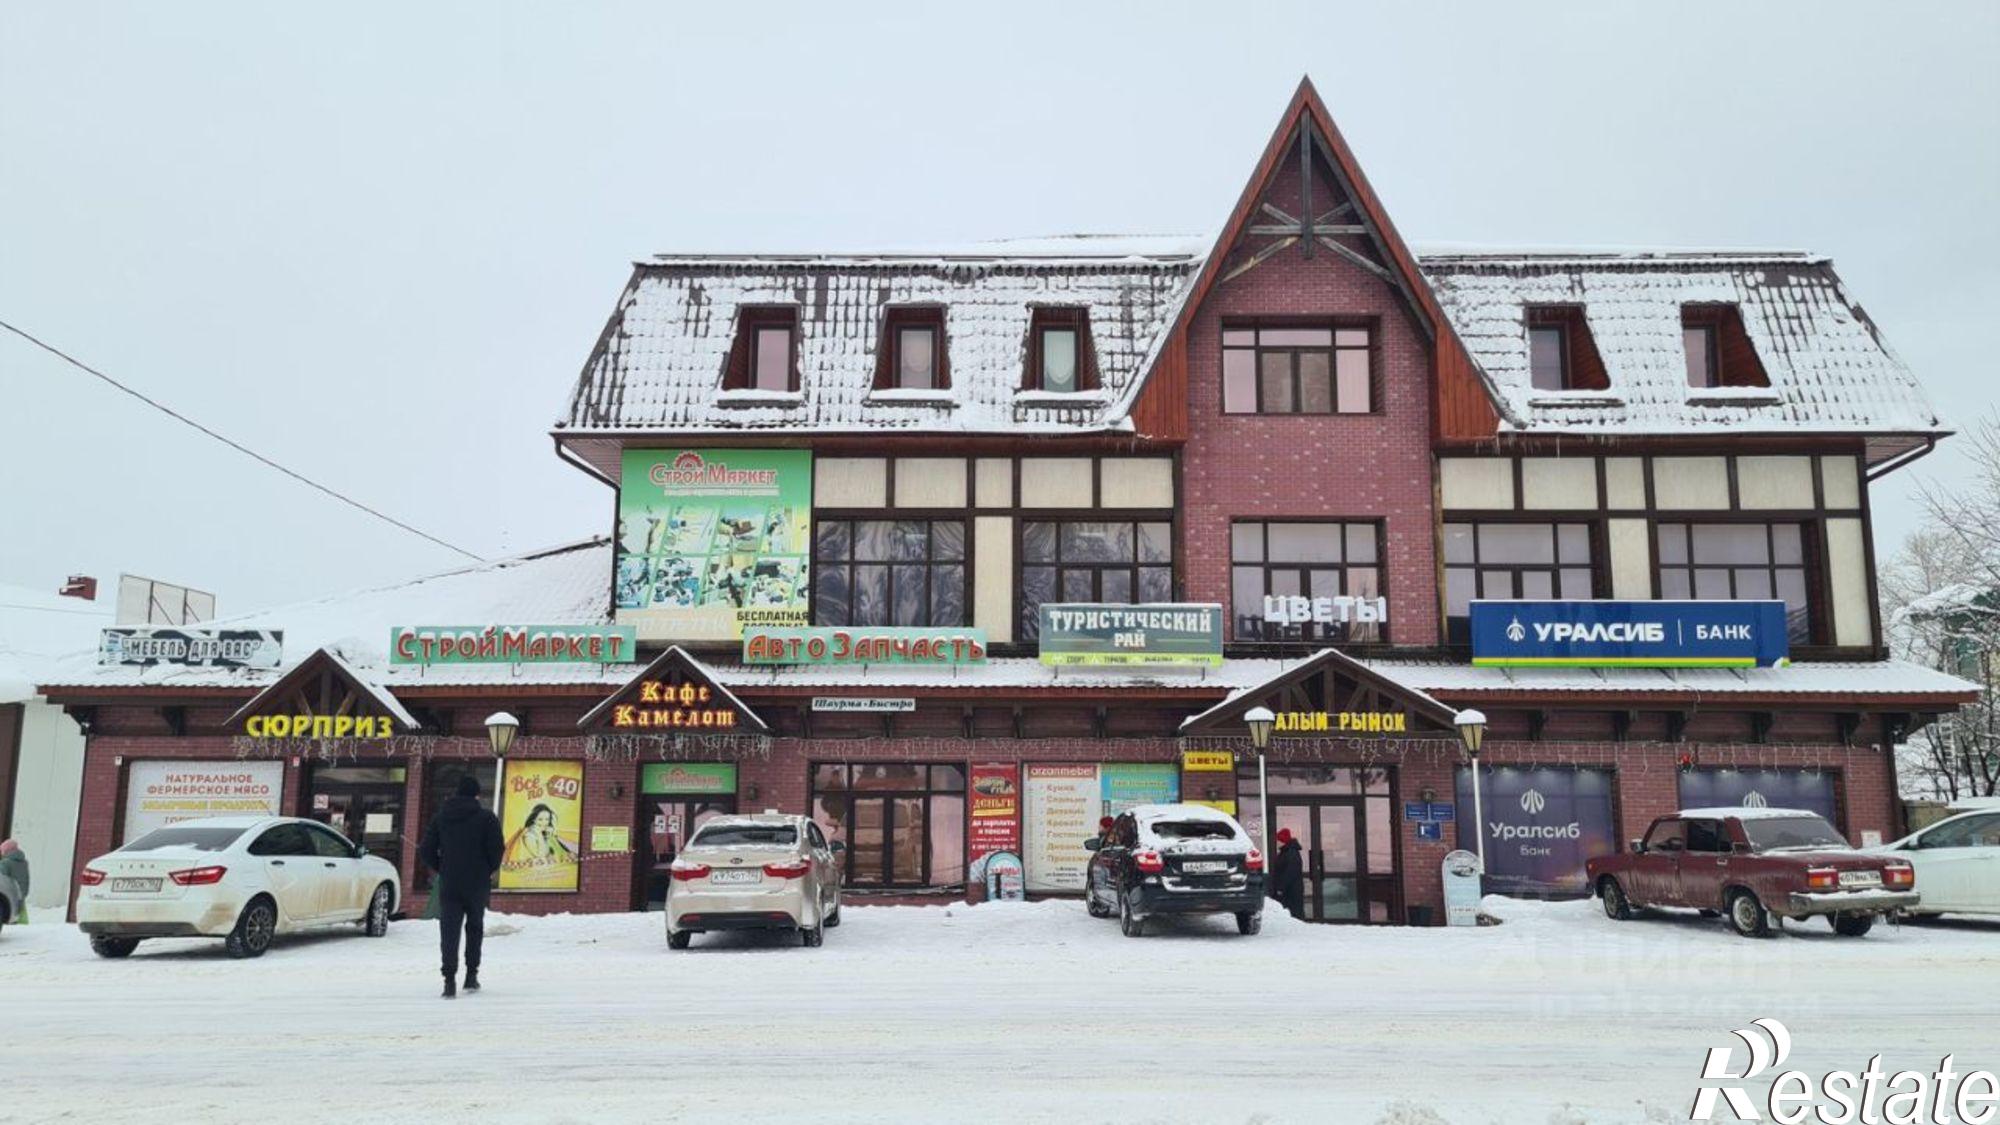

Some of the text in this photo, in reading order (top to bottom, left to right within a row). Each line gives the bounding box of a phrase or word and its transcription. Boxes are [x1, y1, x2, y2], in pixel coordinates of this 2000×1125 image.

[1264, 595, 1387, 626] ЦВЕТЫ
[1050, 609, 1213, 633] ТУРИСТИЧЕСКИЙ
[1113, 630, 1146, 648] РАЙ
[1533, 622, 1752, 642] УРАЛСИБ БАНК
[190, 640, 221, 661] ДЛЯ
[640, 681, 711, 706] Кафе
[613, 704, 736, 727] Камелот
[1340, 711, 1406, 732] РЫНОК
[246, 714, 394, 739] СЮРПРИЗ
[1188, 757, 1228, 765] ЦВЕТЫ
[165, 774, 253, 784] НАТУРАЛЬНОЕ
[553, 778, 578, 796] 40
[146, 785, 270, 795] ФЕРМЕРСКОЕ МЯСО
[1489, 822, 1581, 841] Уралсиб
[1519, 845, 1552, 856] Банк
